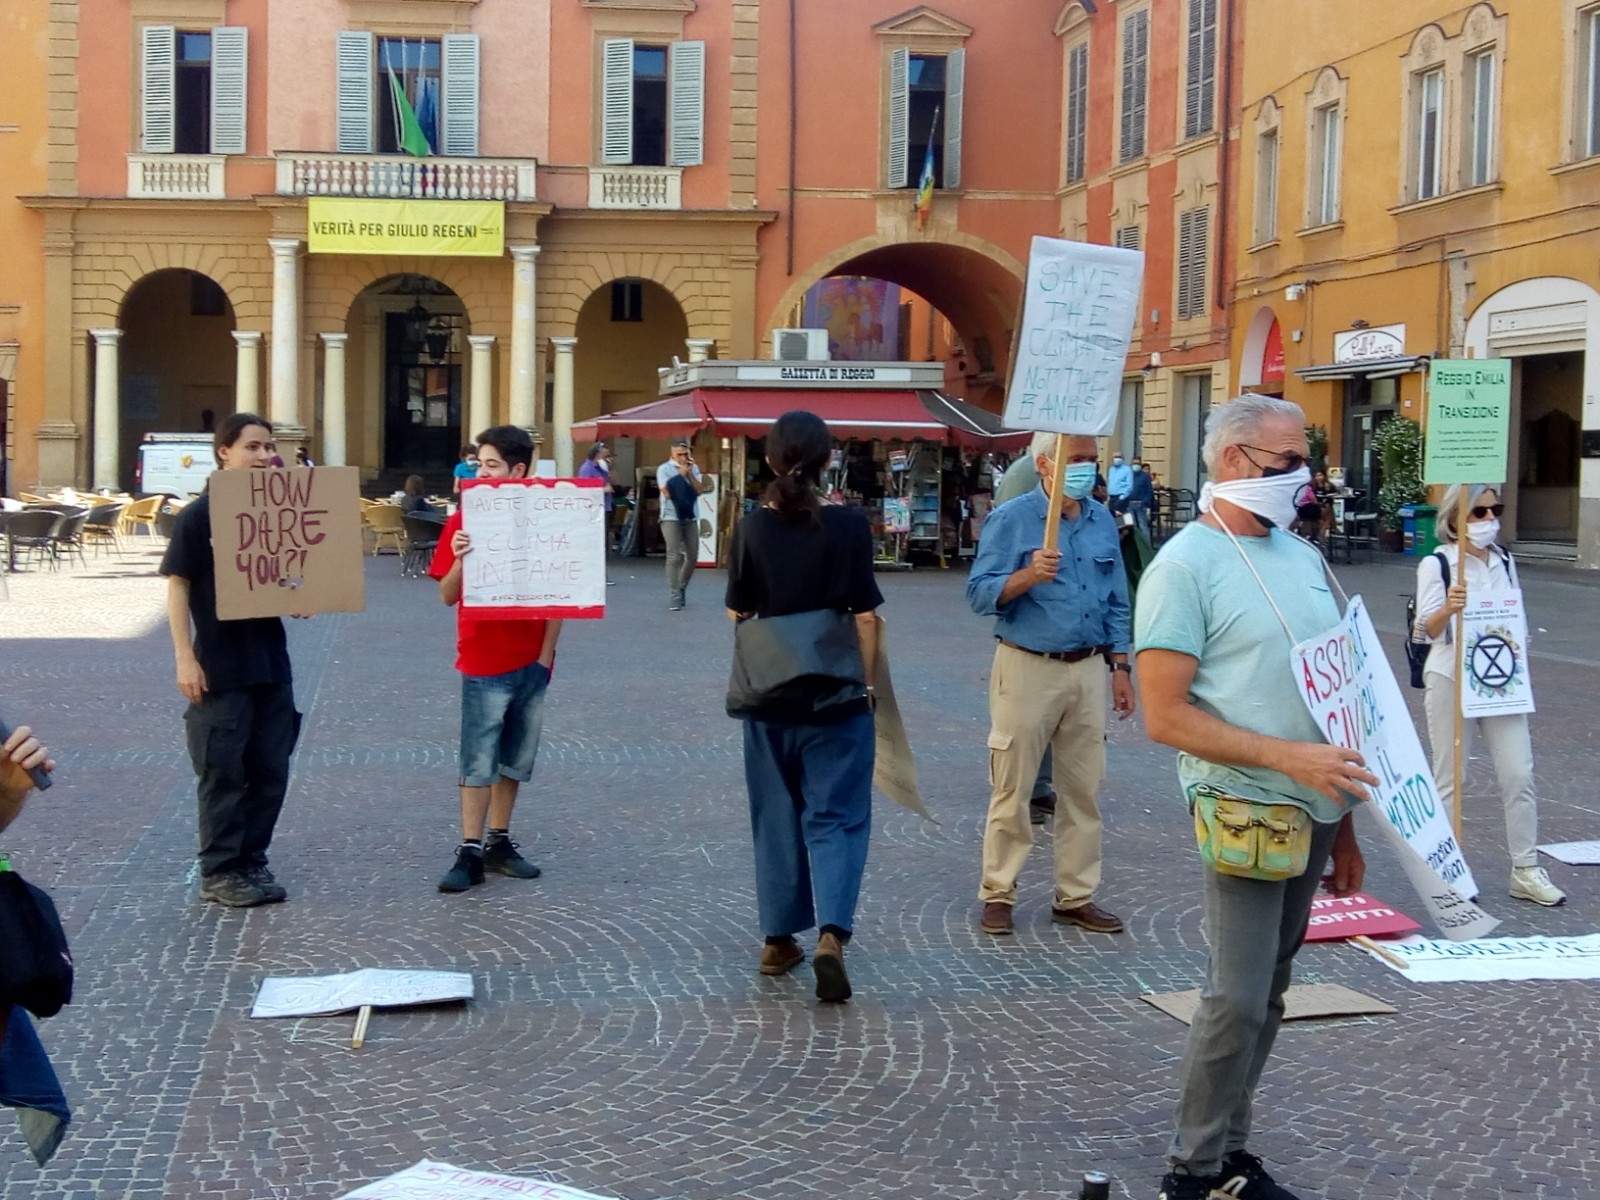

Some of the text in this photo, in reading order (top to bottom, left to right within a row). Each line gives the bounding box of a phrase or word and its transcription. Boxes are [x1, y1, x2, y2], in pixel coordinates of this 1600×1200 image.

[313, 220, 354, 235] VERITÀ
[359, 223, 384, 236] PER
[388, 224, 430, 237] GIULIO
[433, 225, 477, 238] REGENI
[1039, 261, 1120, 299] SAVE
[1045, 301, 1110, 328] THE
[781, 367, 875, 380] GAZZETTA DI REGGIO
[1064, 368, 1110, 392] THE
[1018, 393, 1099, 422] BANKS
[1438, 404, 1500, 419] TRANSIZIONE
[250, 468, 315, 508] HOW
[474, 496, 595, 511] AVETE CREATO
[235, 507, 329, 556] DARE
[515, 516, 539, 527] UN
[487, 533, 571, 551] CLIMA
[475, 559, 583, 583] INFAME
